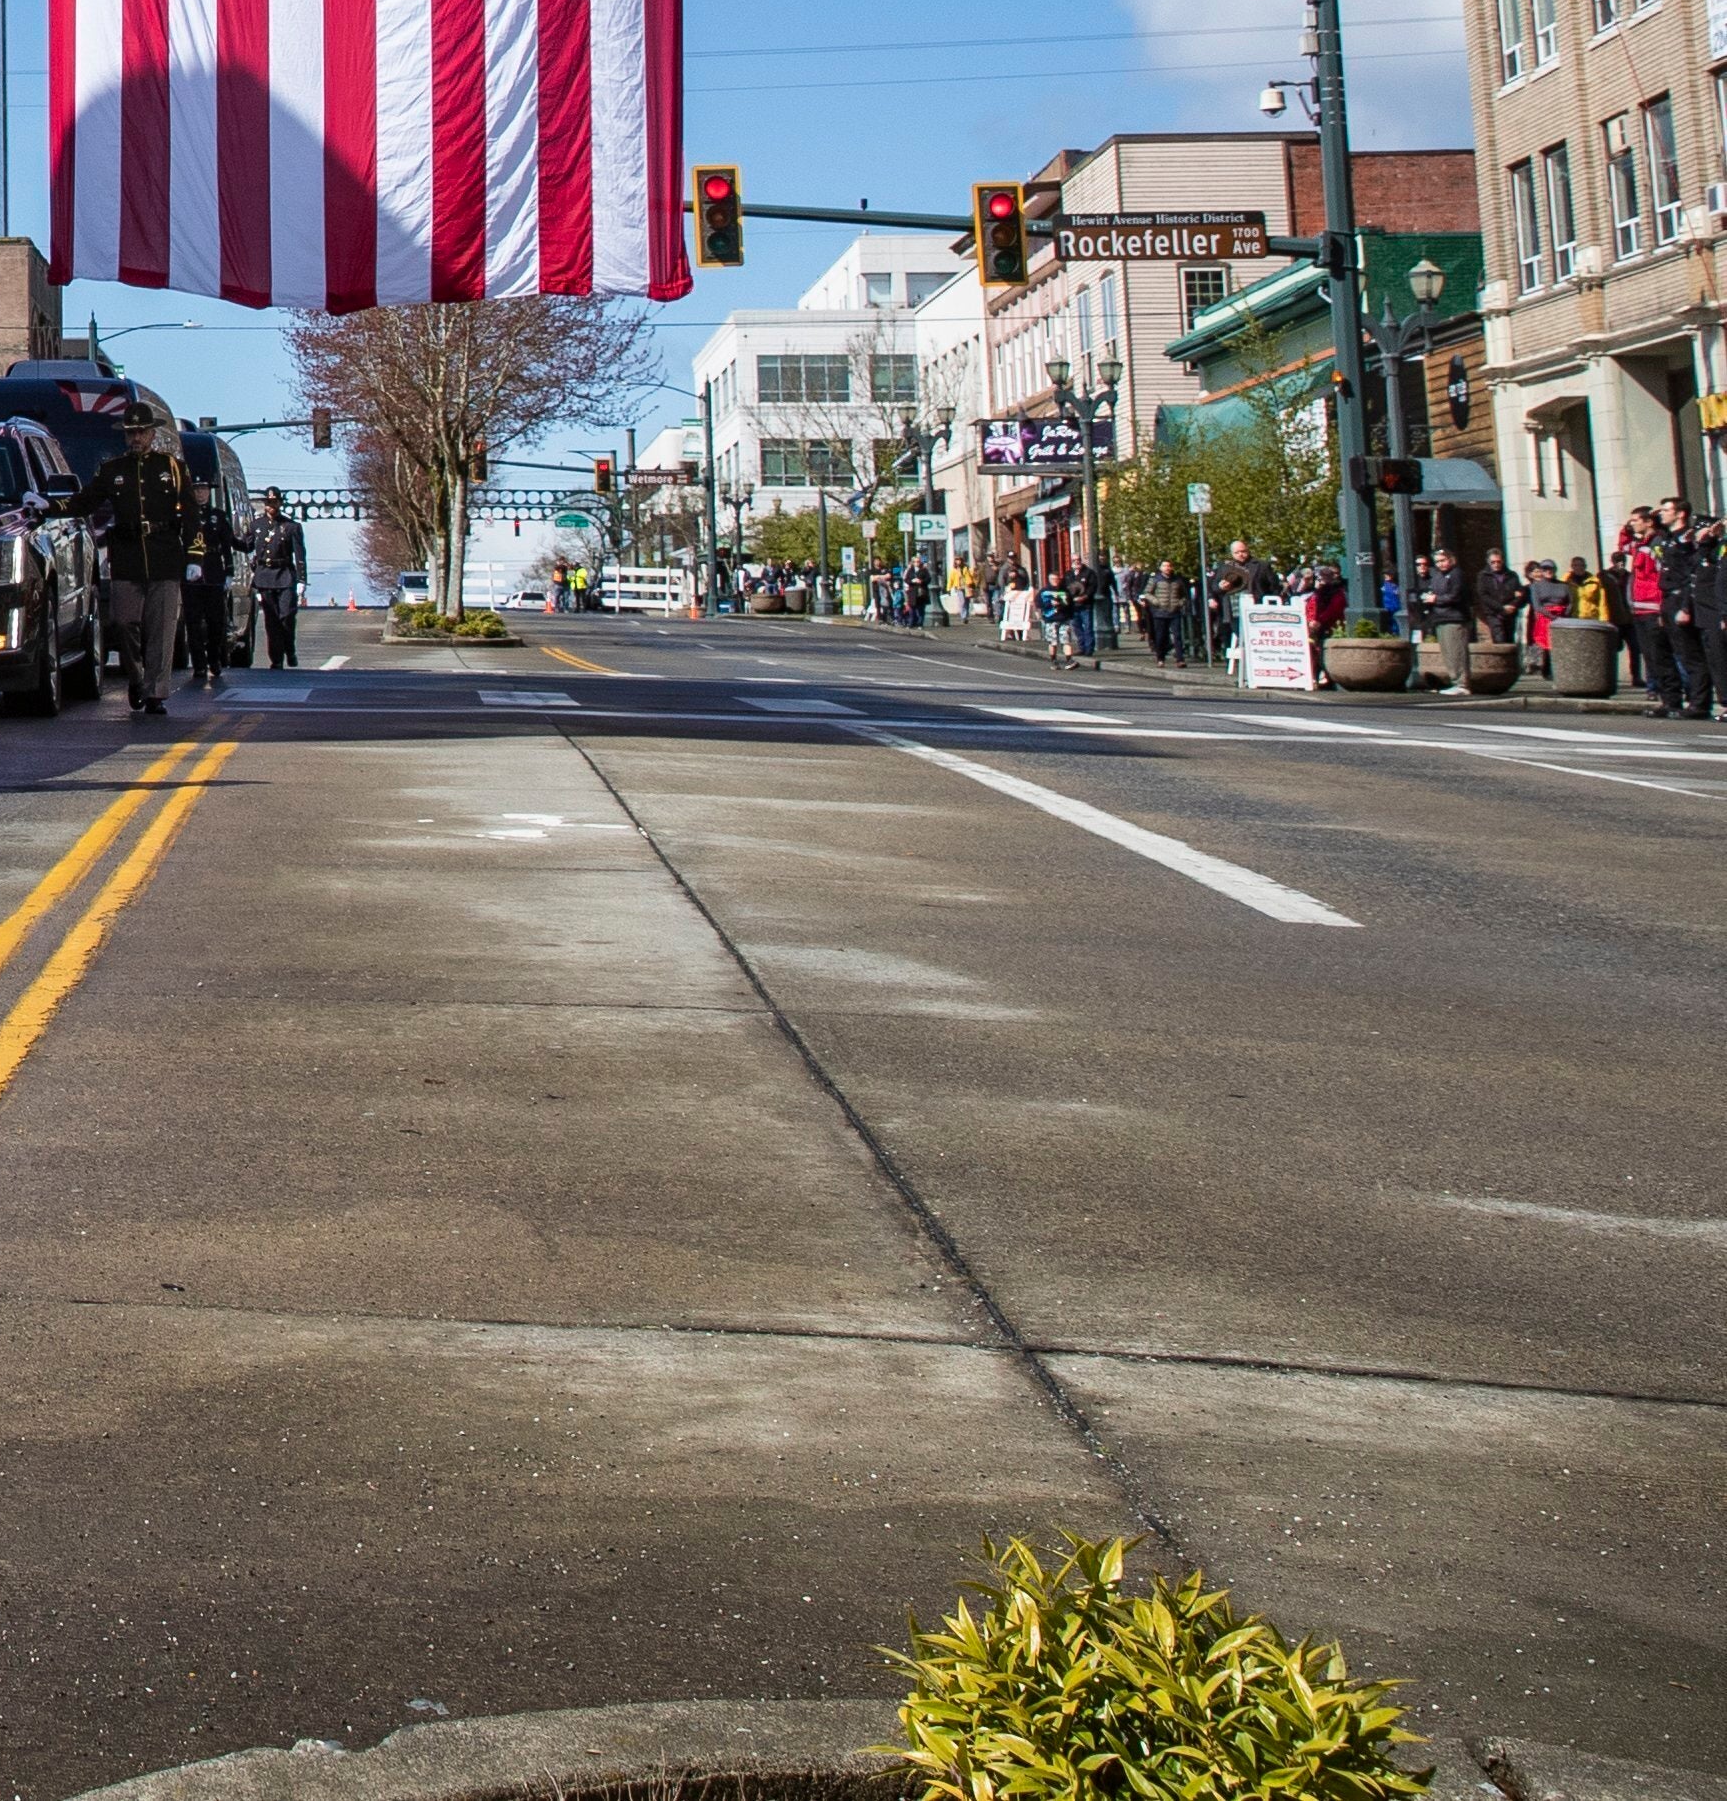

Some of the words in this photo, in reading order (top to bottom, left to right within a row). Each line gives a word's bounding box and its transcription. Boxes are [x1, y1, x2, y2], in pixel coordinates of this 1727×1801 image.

[1071, 215, 1108, 226] Hewitt
[1113, 214, 1153, 225] Avenue
[1156, 213, 1200, 225] Historic
[1203, 213, 1245, 224] District
[1232, 227, 1260, 238] 1700
[1059, 228, 1221, 257] Rockefeller
[1233, 240, 1261, 254] Ave
[1057, 442, 1067, 455] &
[1069, 442, 1109, 458] Longe
[628, 474, 674, 484] Wetmore
[919, 520, 933, 535] P
[1259, 630, 1274, 638] WE
[1250, 639, 1304, 648] CATERING
